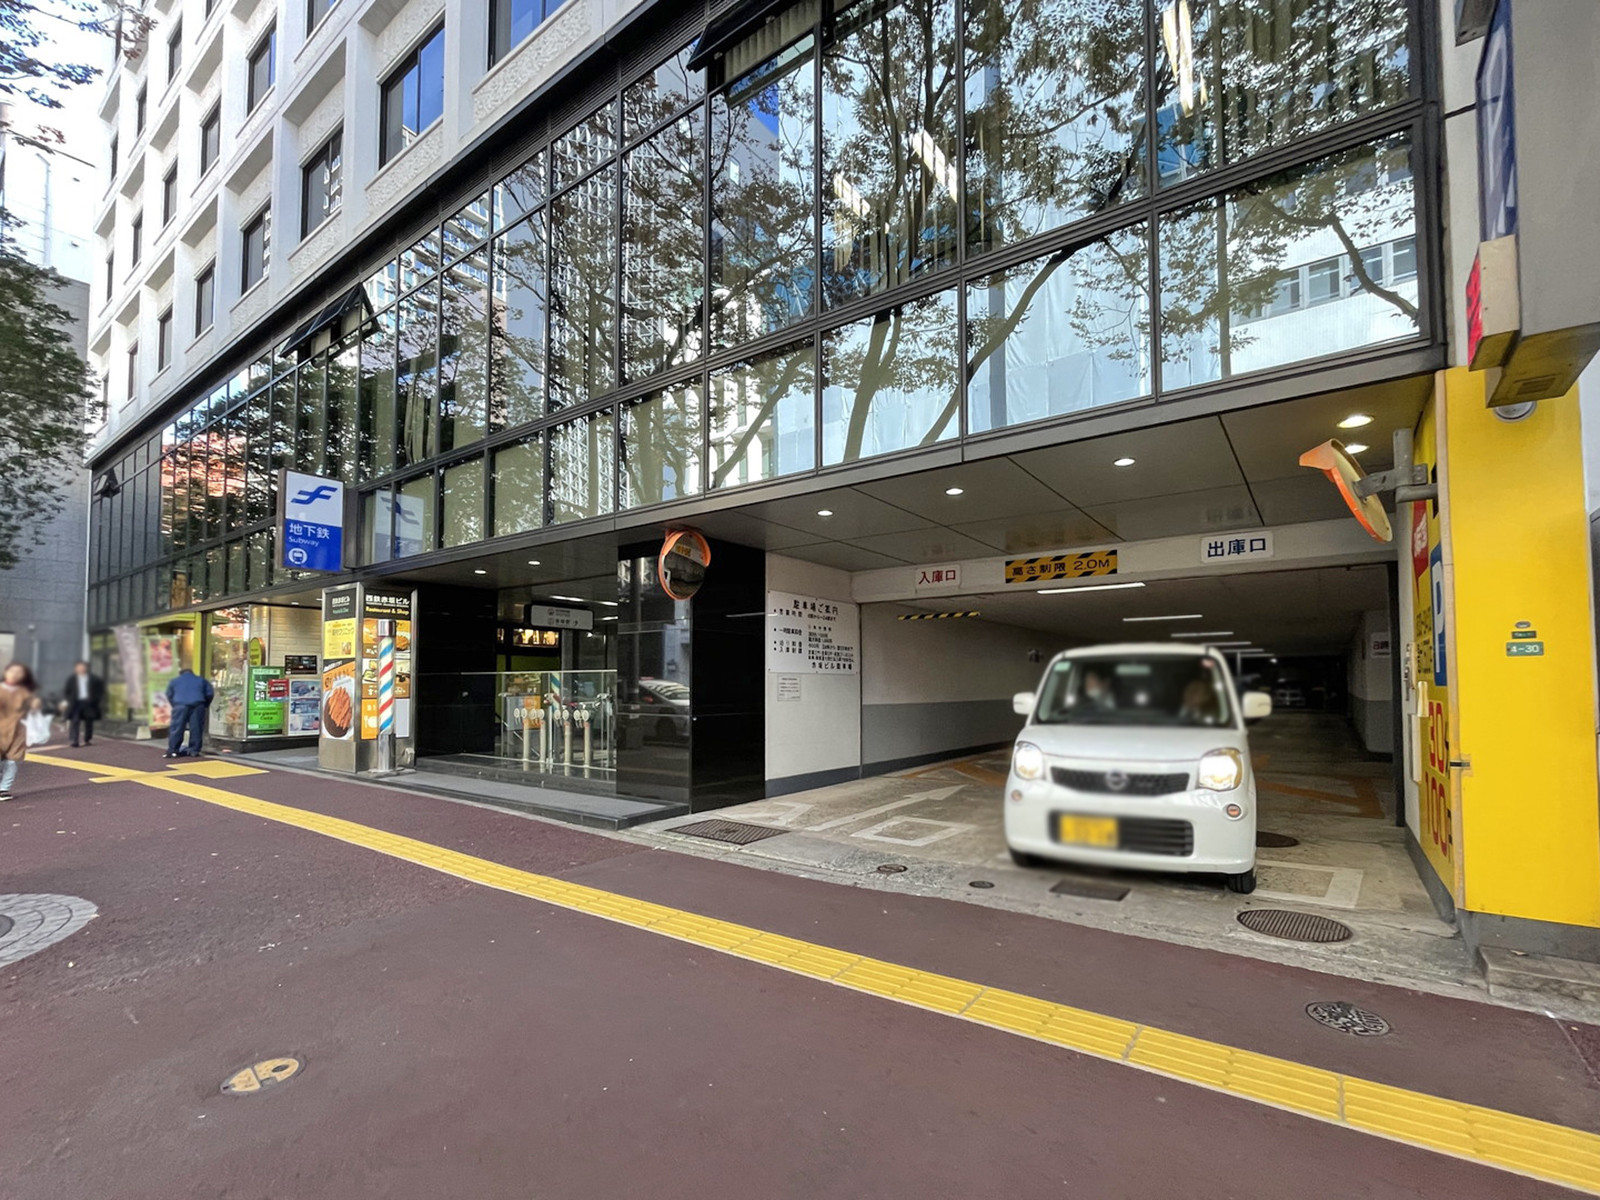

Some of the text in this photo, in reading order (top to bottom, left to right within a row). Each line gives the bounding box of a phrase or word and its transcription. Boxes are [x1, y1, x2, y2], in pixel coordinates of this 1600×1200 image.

[289, 523, 330, 540] 地下鉄
[288, 536, 320, 547] Subway
[1207, 537, 1267, 559] 出庫口
[918, 568, 957, 585] 入庫口
[1012, 559, 1110, 577] 高さ制限 2.0M
[396, 608, 410, 616] Shop
[793, 599, 839, 616] 駐車場ご案内
